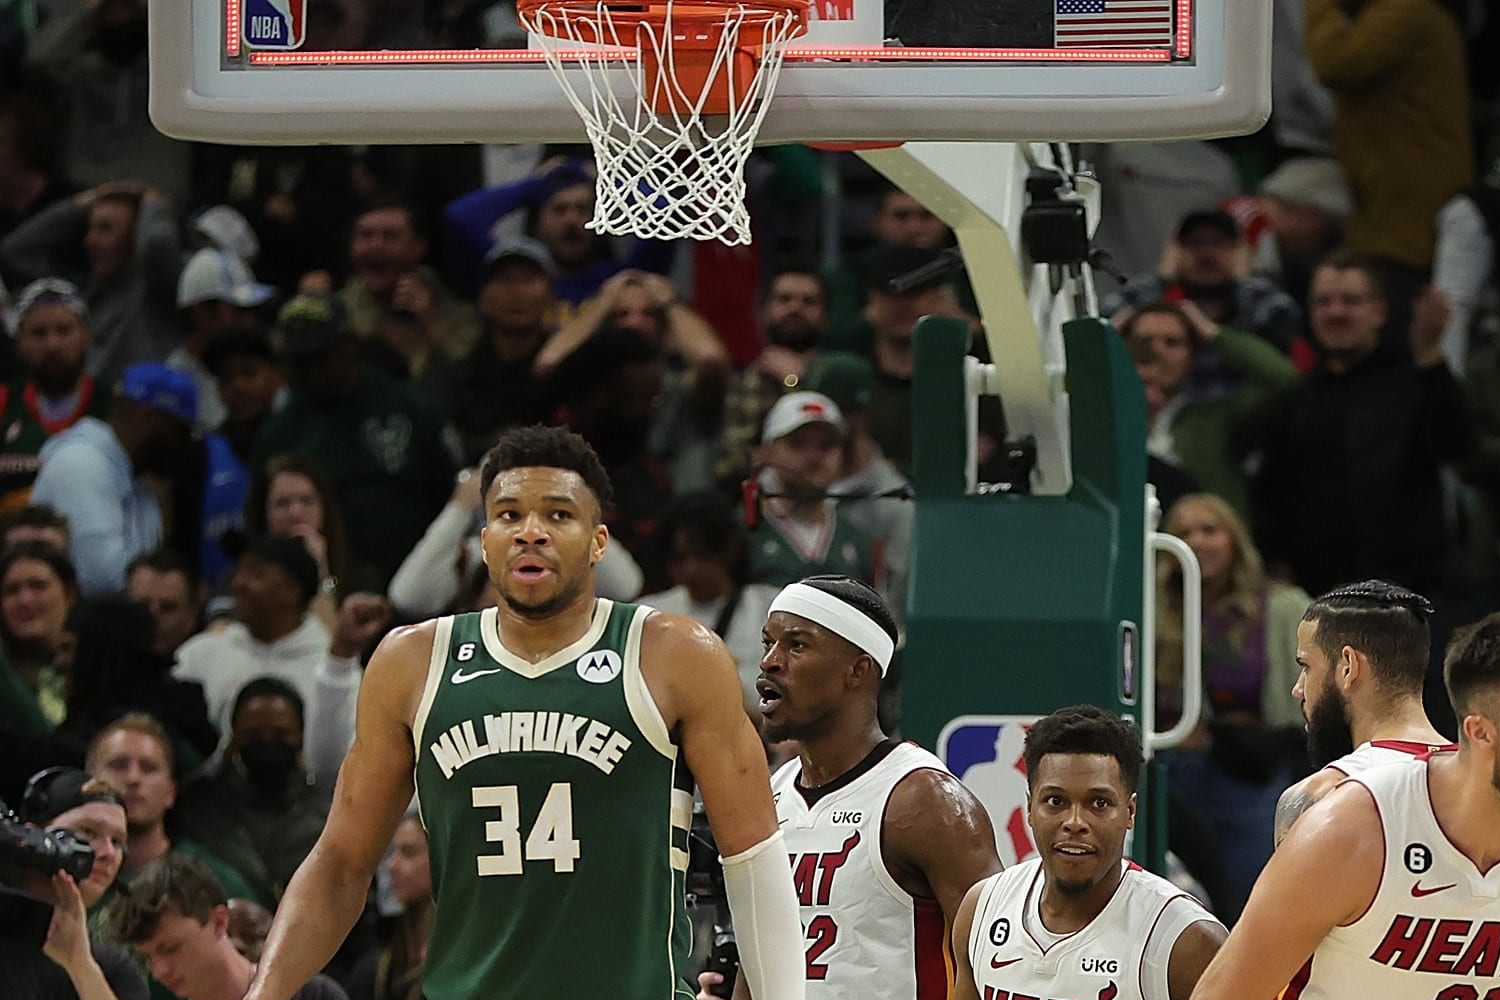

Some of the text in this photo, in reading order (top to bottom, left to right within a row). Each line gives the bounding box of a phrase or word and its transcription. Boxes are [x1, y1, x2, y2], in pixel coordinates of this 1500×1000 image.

[251, 16, 281, 39] NBA
[457, 643, 476, 661] 6
[430, 711, 632, 780] MILWAUKEE
[471, 782, 581, 877] 34
[801, 915, 838, 980] 2
